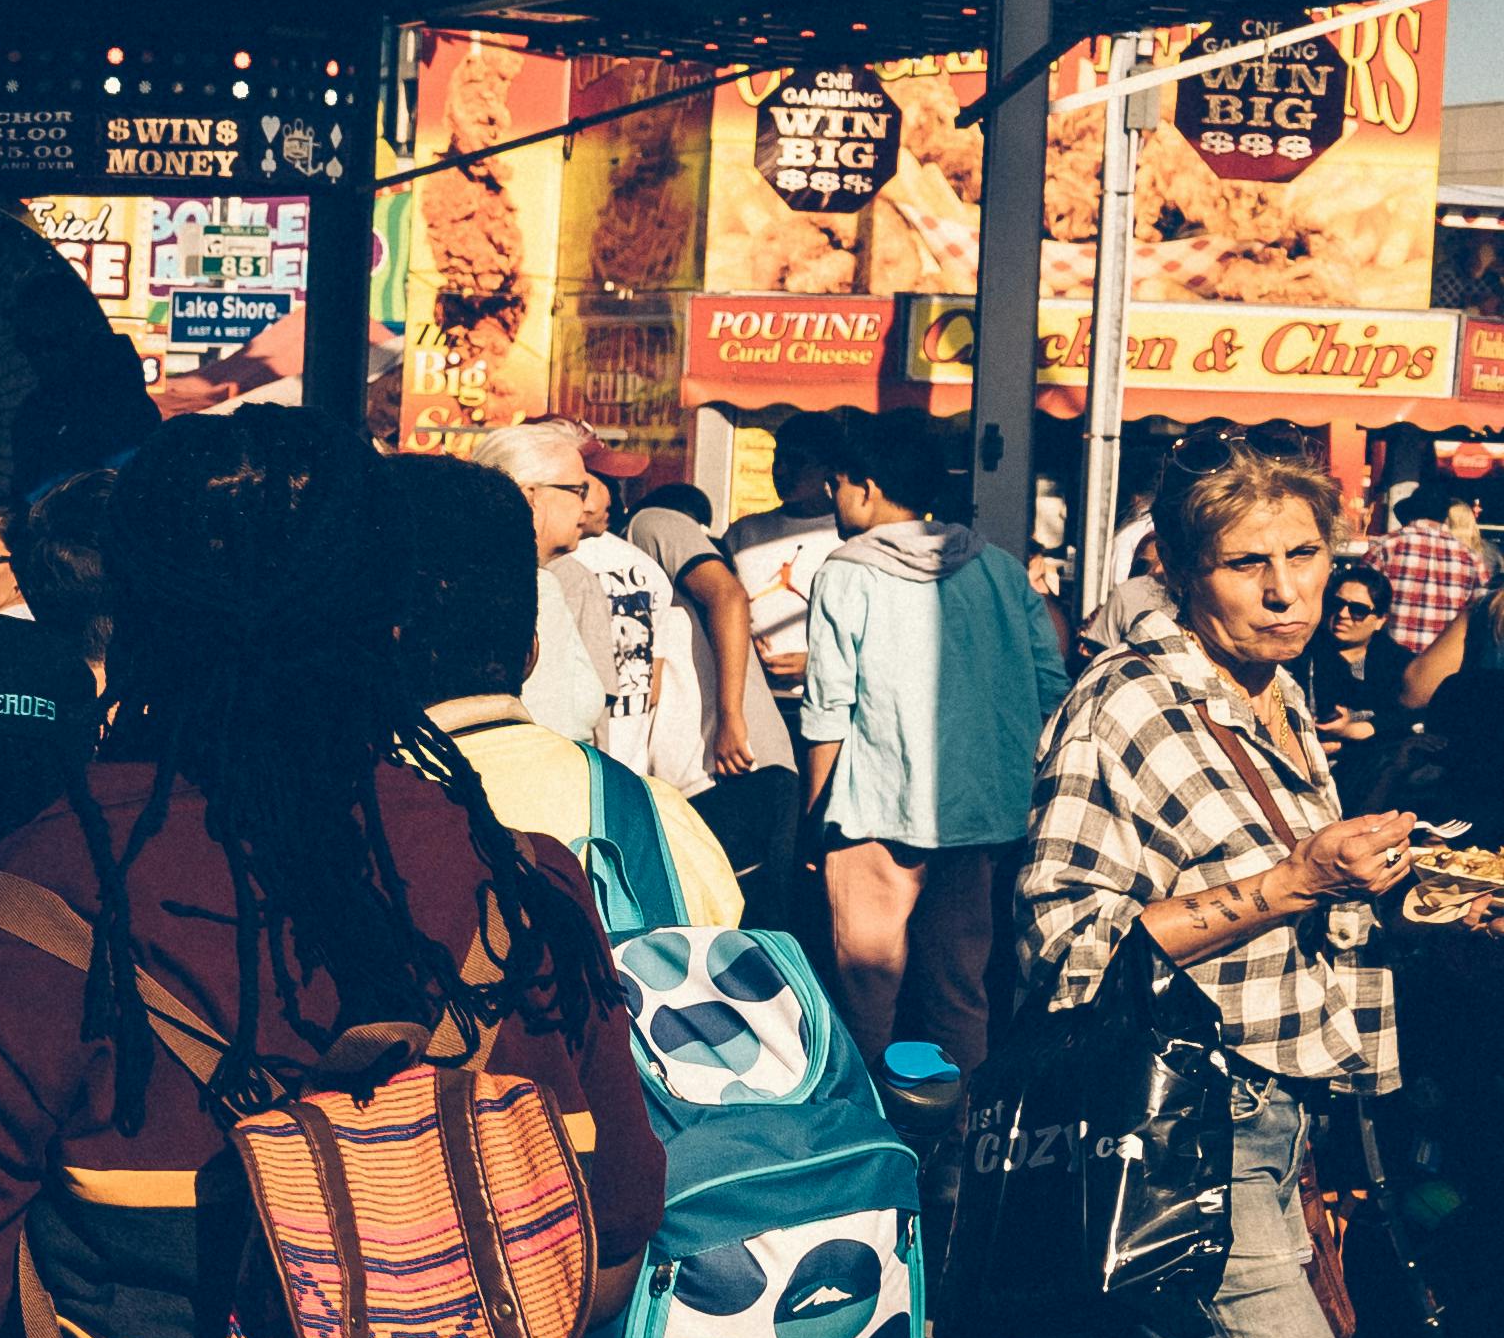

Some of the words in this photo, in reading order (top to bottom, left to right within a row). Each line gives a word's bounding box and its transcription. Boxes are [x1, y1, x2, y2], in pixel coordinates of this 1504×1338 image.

[815, 71, 853, 89] CNE
[1201, 61, 1335, 96] WIN
[781, 87, 884, 108] GAMBLING
[1201, 94, 1317, 131] BIG
[769, 106, 892, 139] WIN
[106, 149, 239, 177] MONEY
[776, 137, 878, 169] BIG
[27, 202, 111, 243] Fried
[221, 256, 267, 277] 851
[174, 295, 219, 319] Lake
[222, 295, 277, 320] Shore
[707, 311, 882, 342] POUTINE
[719, 340, 782, 363] Curd
[786, 341, 874, 366] Cheese
[1192, 328, 1245, 373] &
[1261, 321, 1438, 389] Chips
[412, 350, 488, 407] Big
